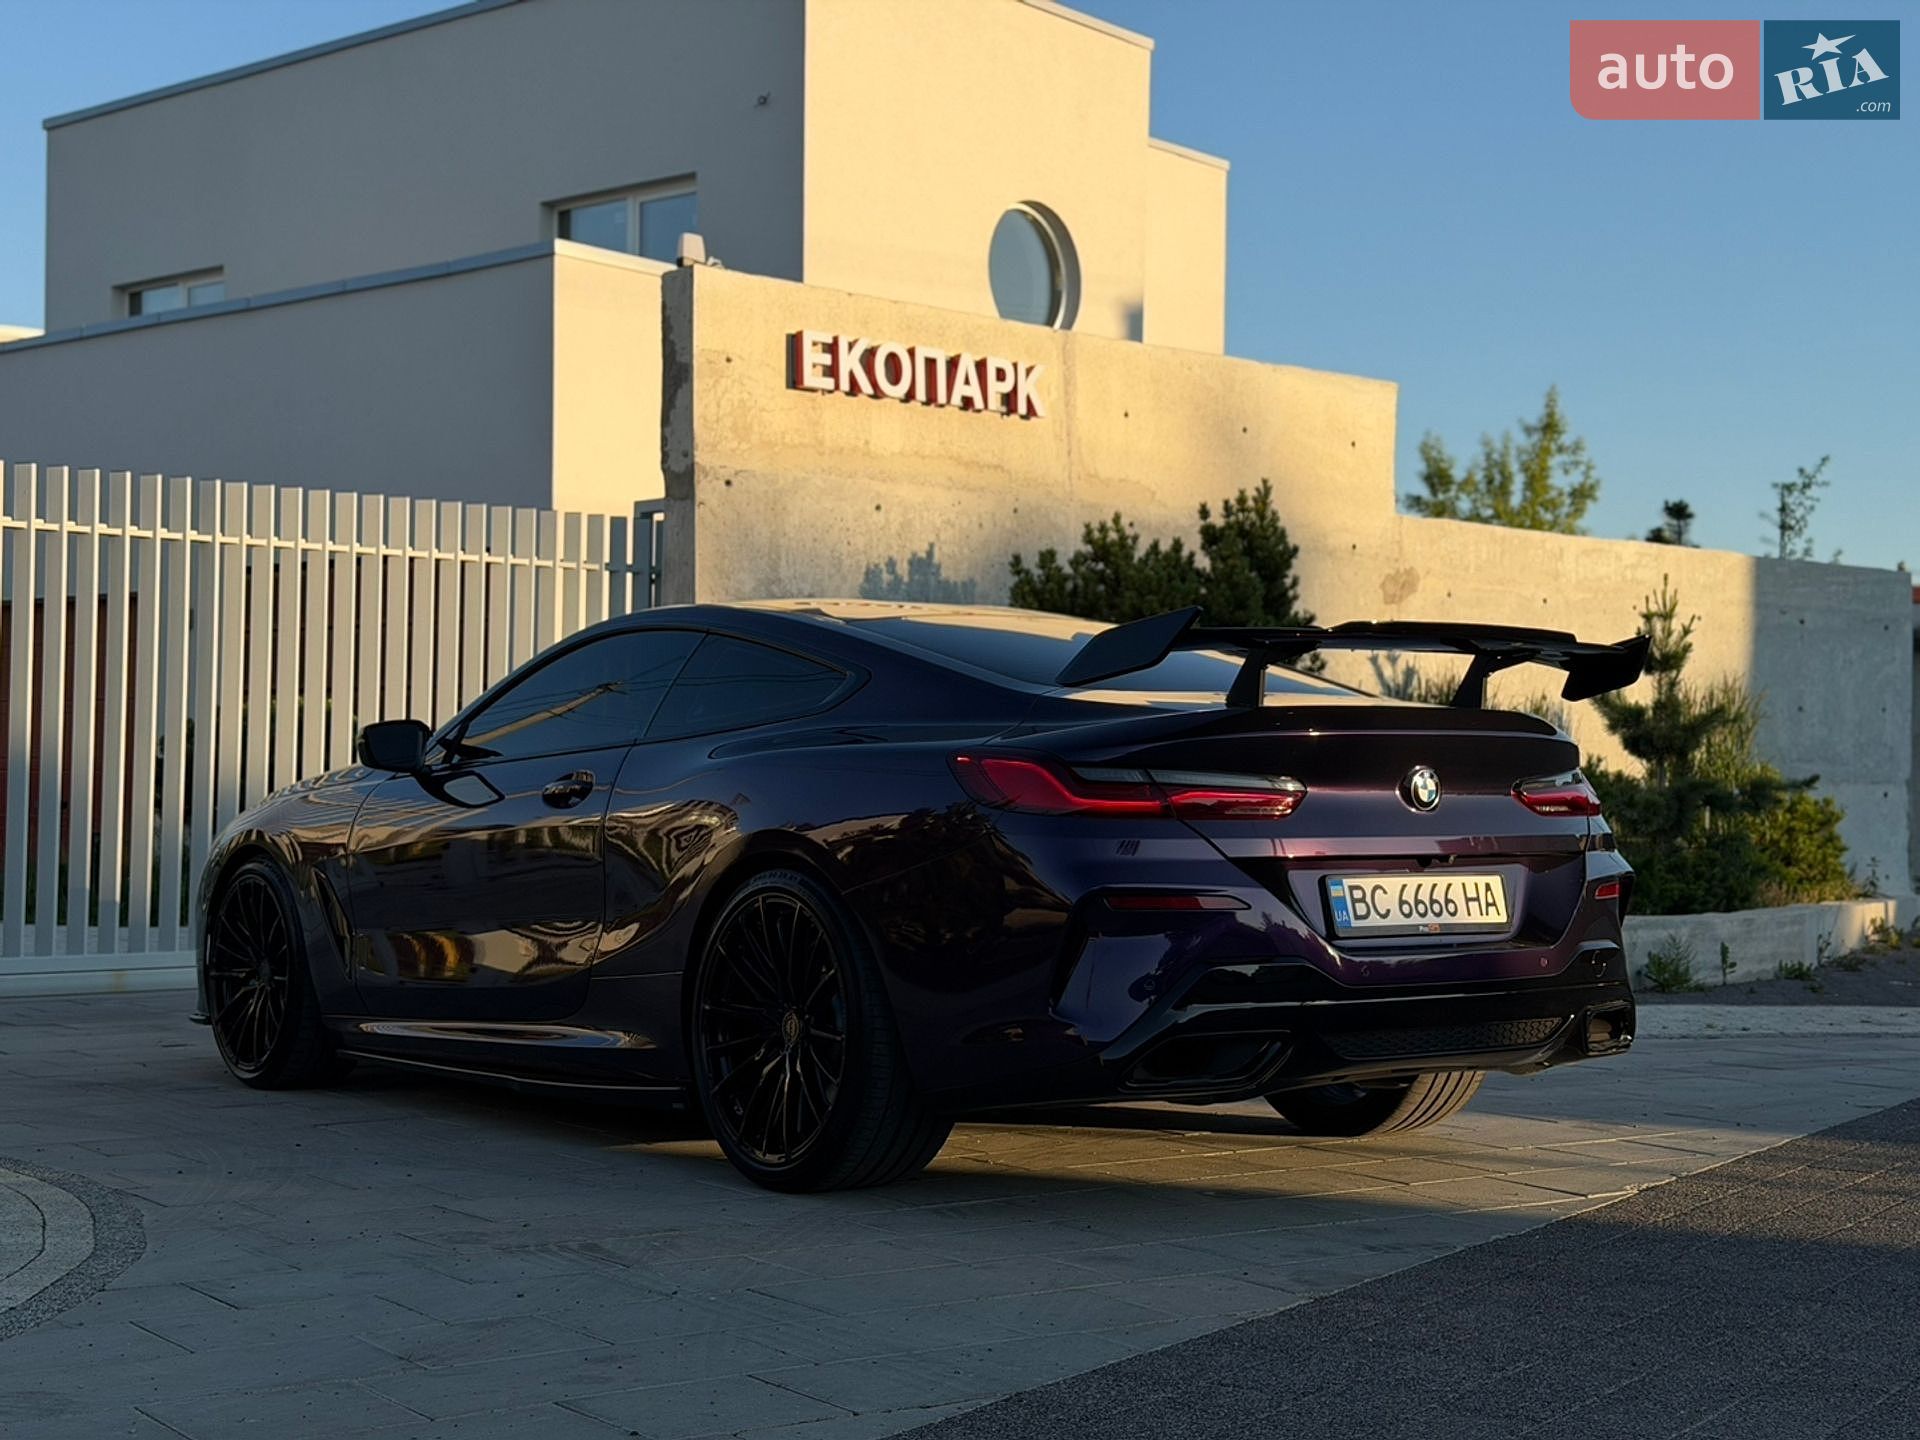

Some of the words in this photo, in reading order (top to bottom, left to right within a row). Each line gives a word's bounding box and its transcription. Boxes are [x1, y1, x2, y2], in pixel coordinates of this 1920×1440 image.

[795, 329, 1047, 418] ЕКОПАРК
[1334, 910, 1349, 921] UA
[1348, 882, 1391, 920] BC
[1398, 883, 1458, 918] 6666
[1462, 881, 1501, 916] HA
